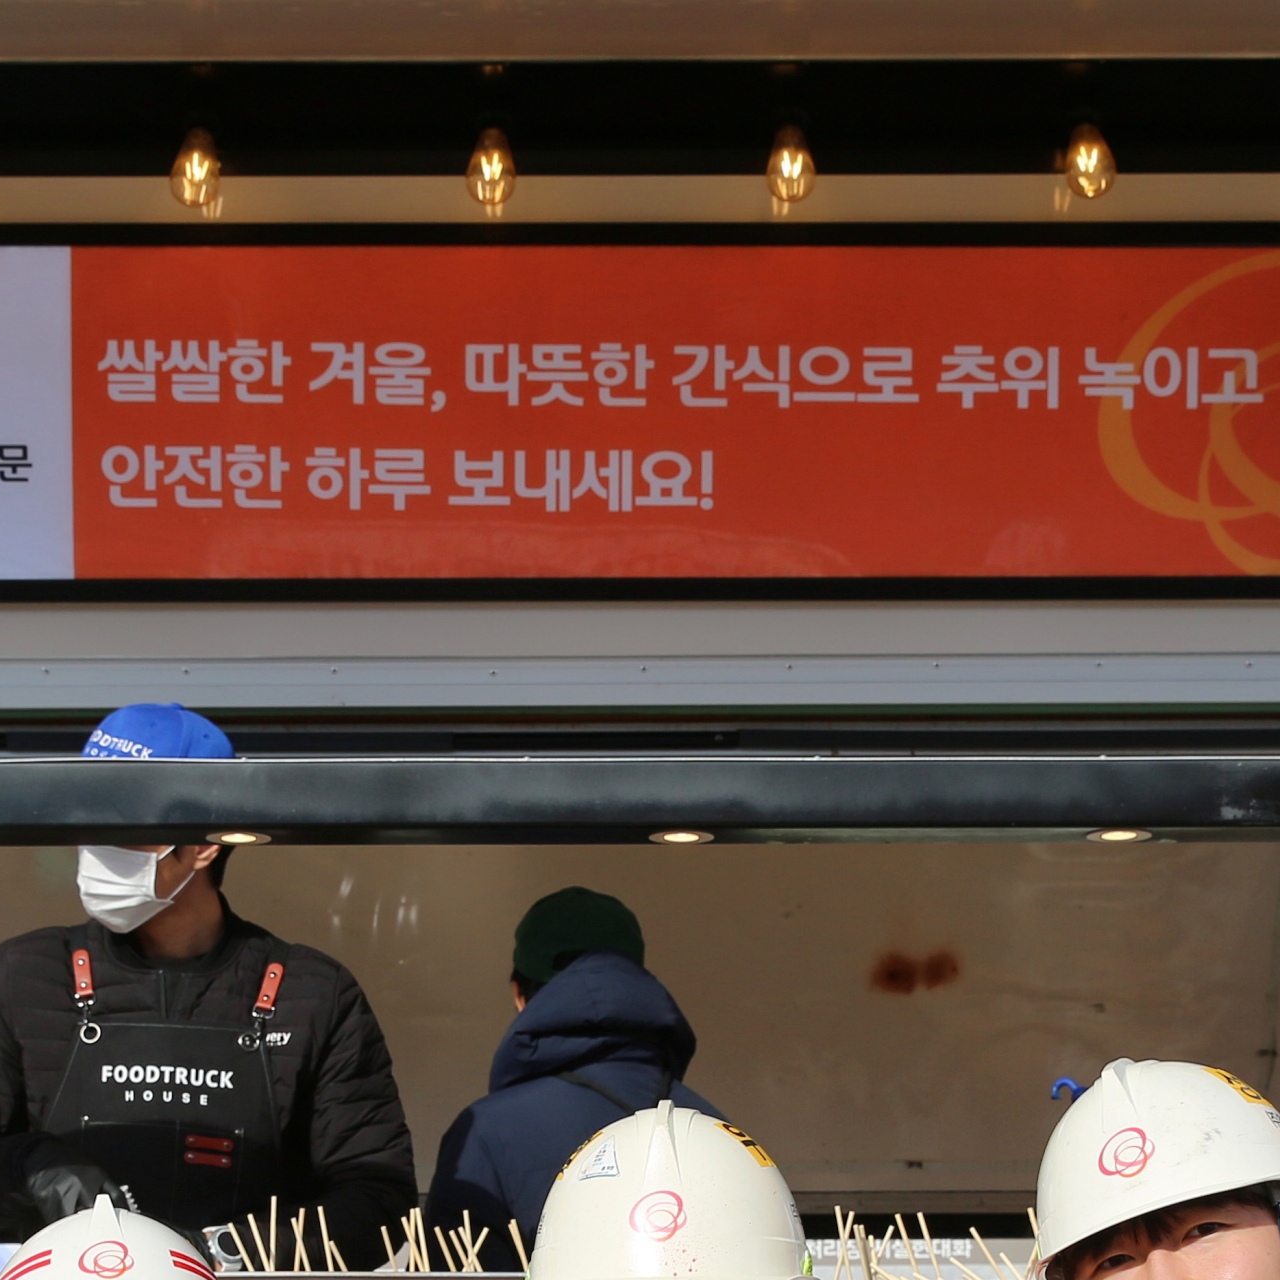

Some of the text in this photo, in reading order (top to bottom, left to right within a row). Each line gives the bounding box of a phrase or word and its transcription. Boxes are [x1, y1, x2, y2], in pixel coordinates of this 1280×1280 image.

[97, 338, 1264, 412] 쌀쌀한 겨울, 따뜻한 간식으로 추위 녹이고
[100, 444, 715, 512] 안전한 하루 보내세요!
[101, 1065, 234, 1089] FOODTRUCK
[125, 1090, 208, 1106] HOUSE
